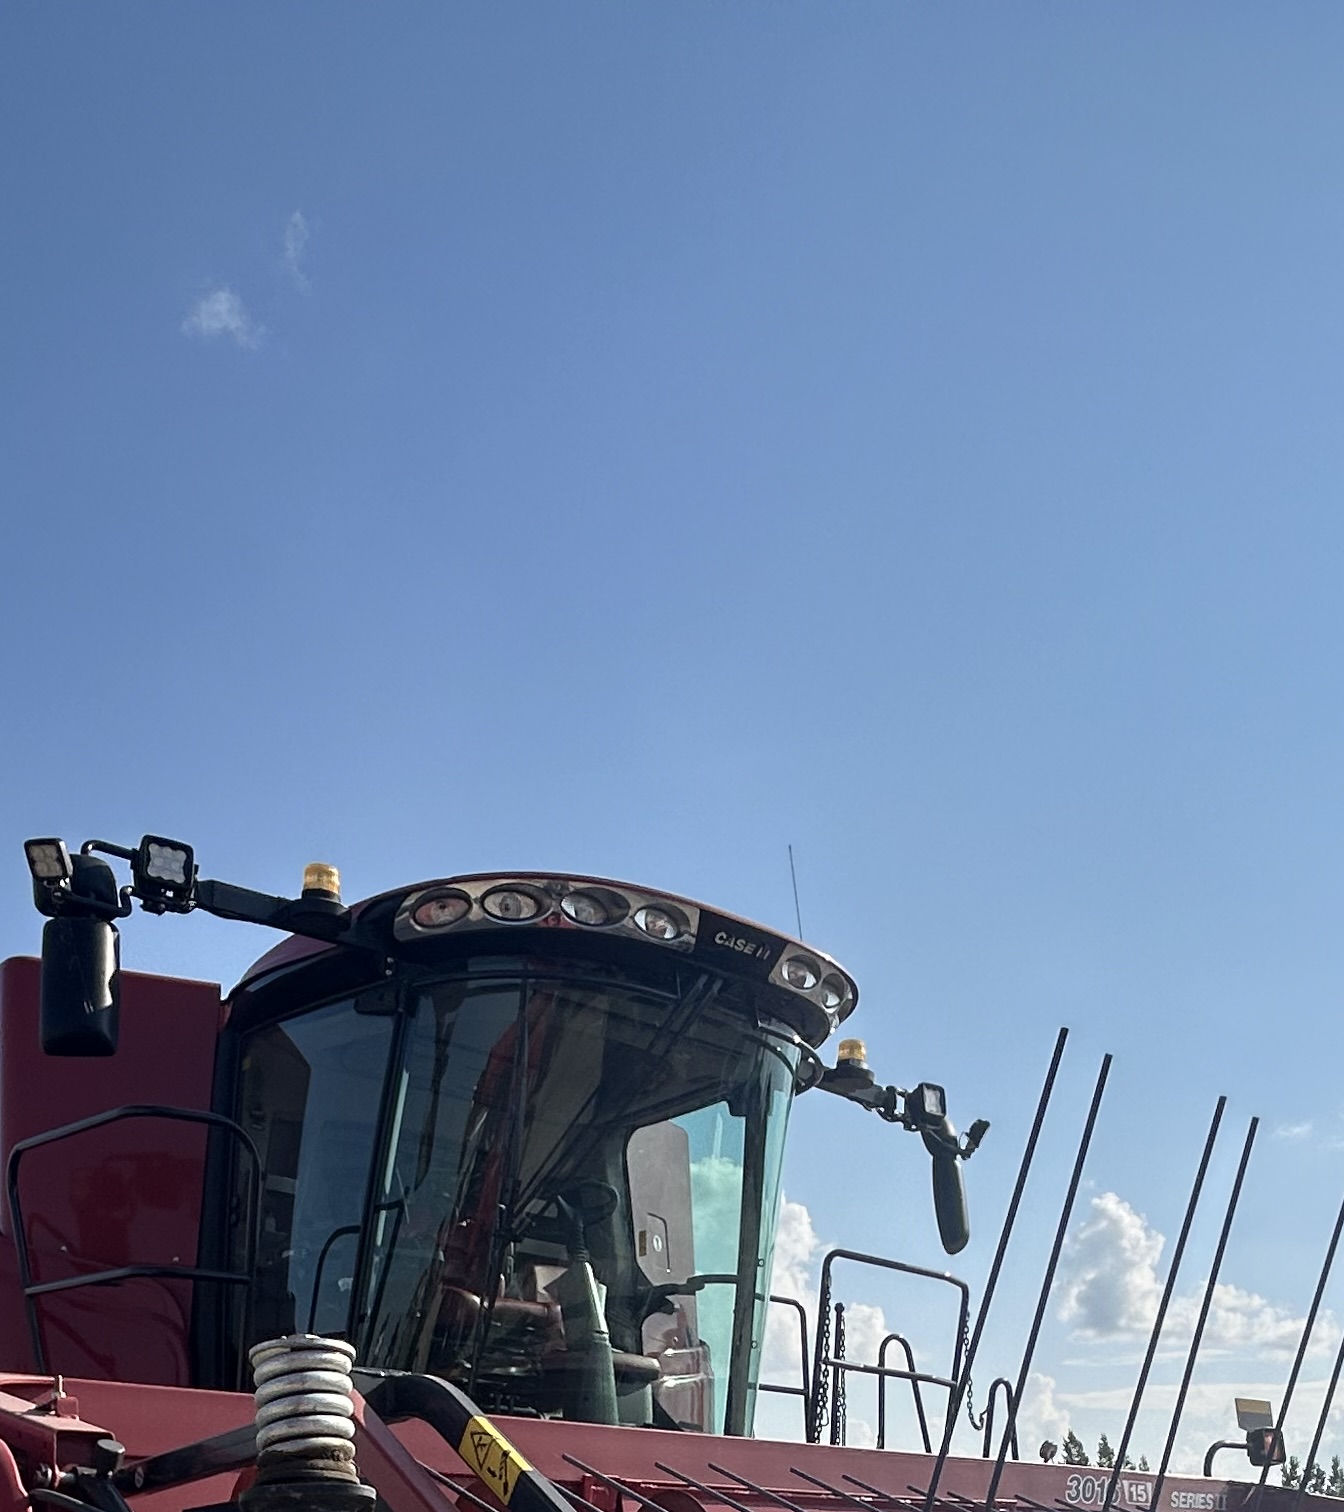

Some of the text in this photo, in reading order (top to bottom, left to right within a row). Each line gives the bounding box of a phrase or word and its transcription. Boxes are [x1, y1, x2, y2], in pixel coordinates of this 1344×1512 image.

[714, 931, 757, 955] CASE
[1130, 1484, 1147, 1502] 15
[1170, 1491, 1214, 1510] SERIES
